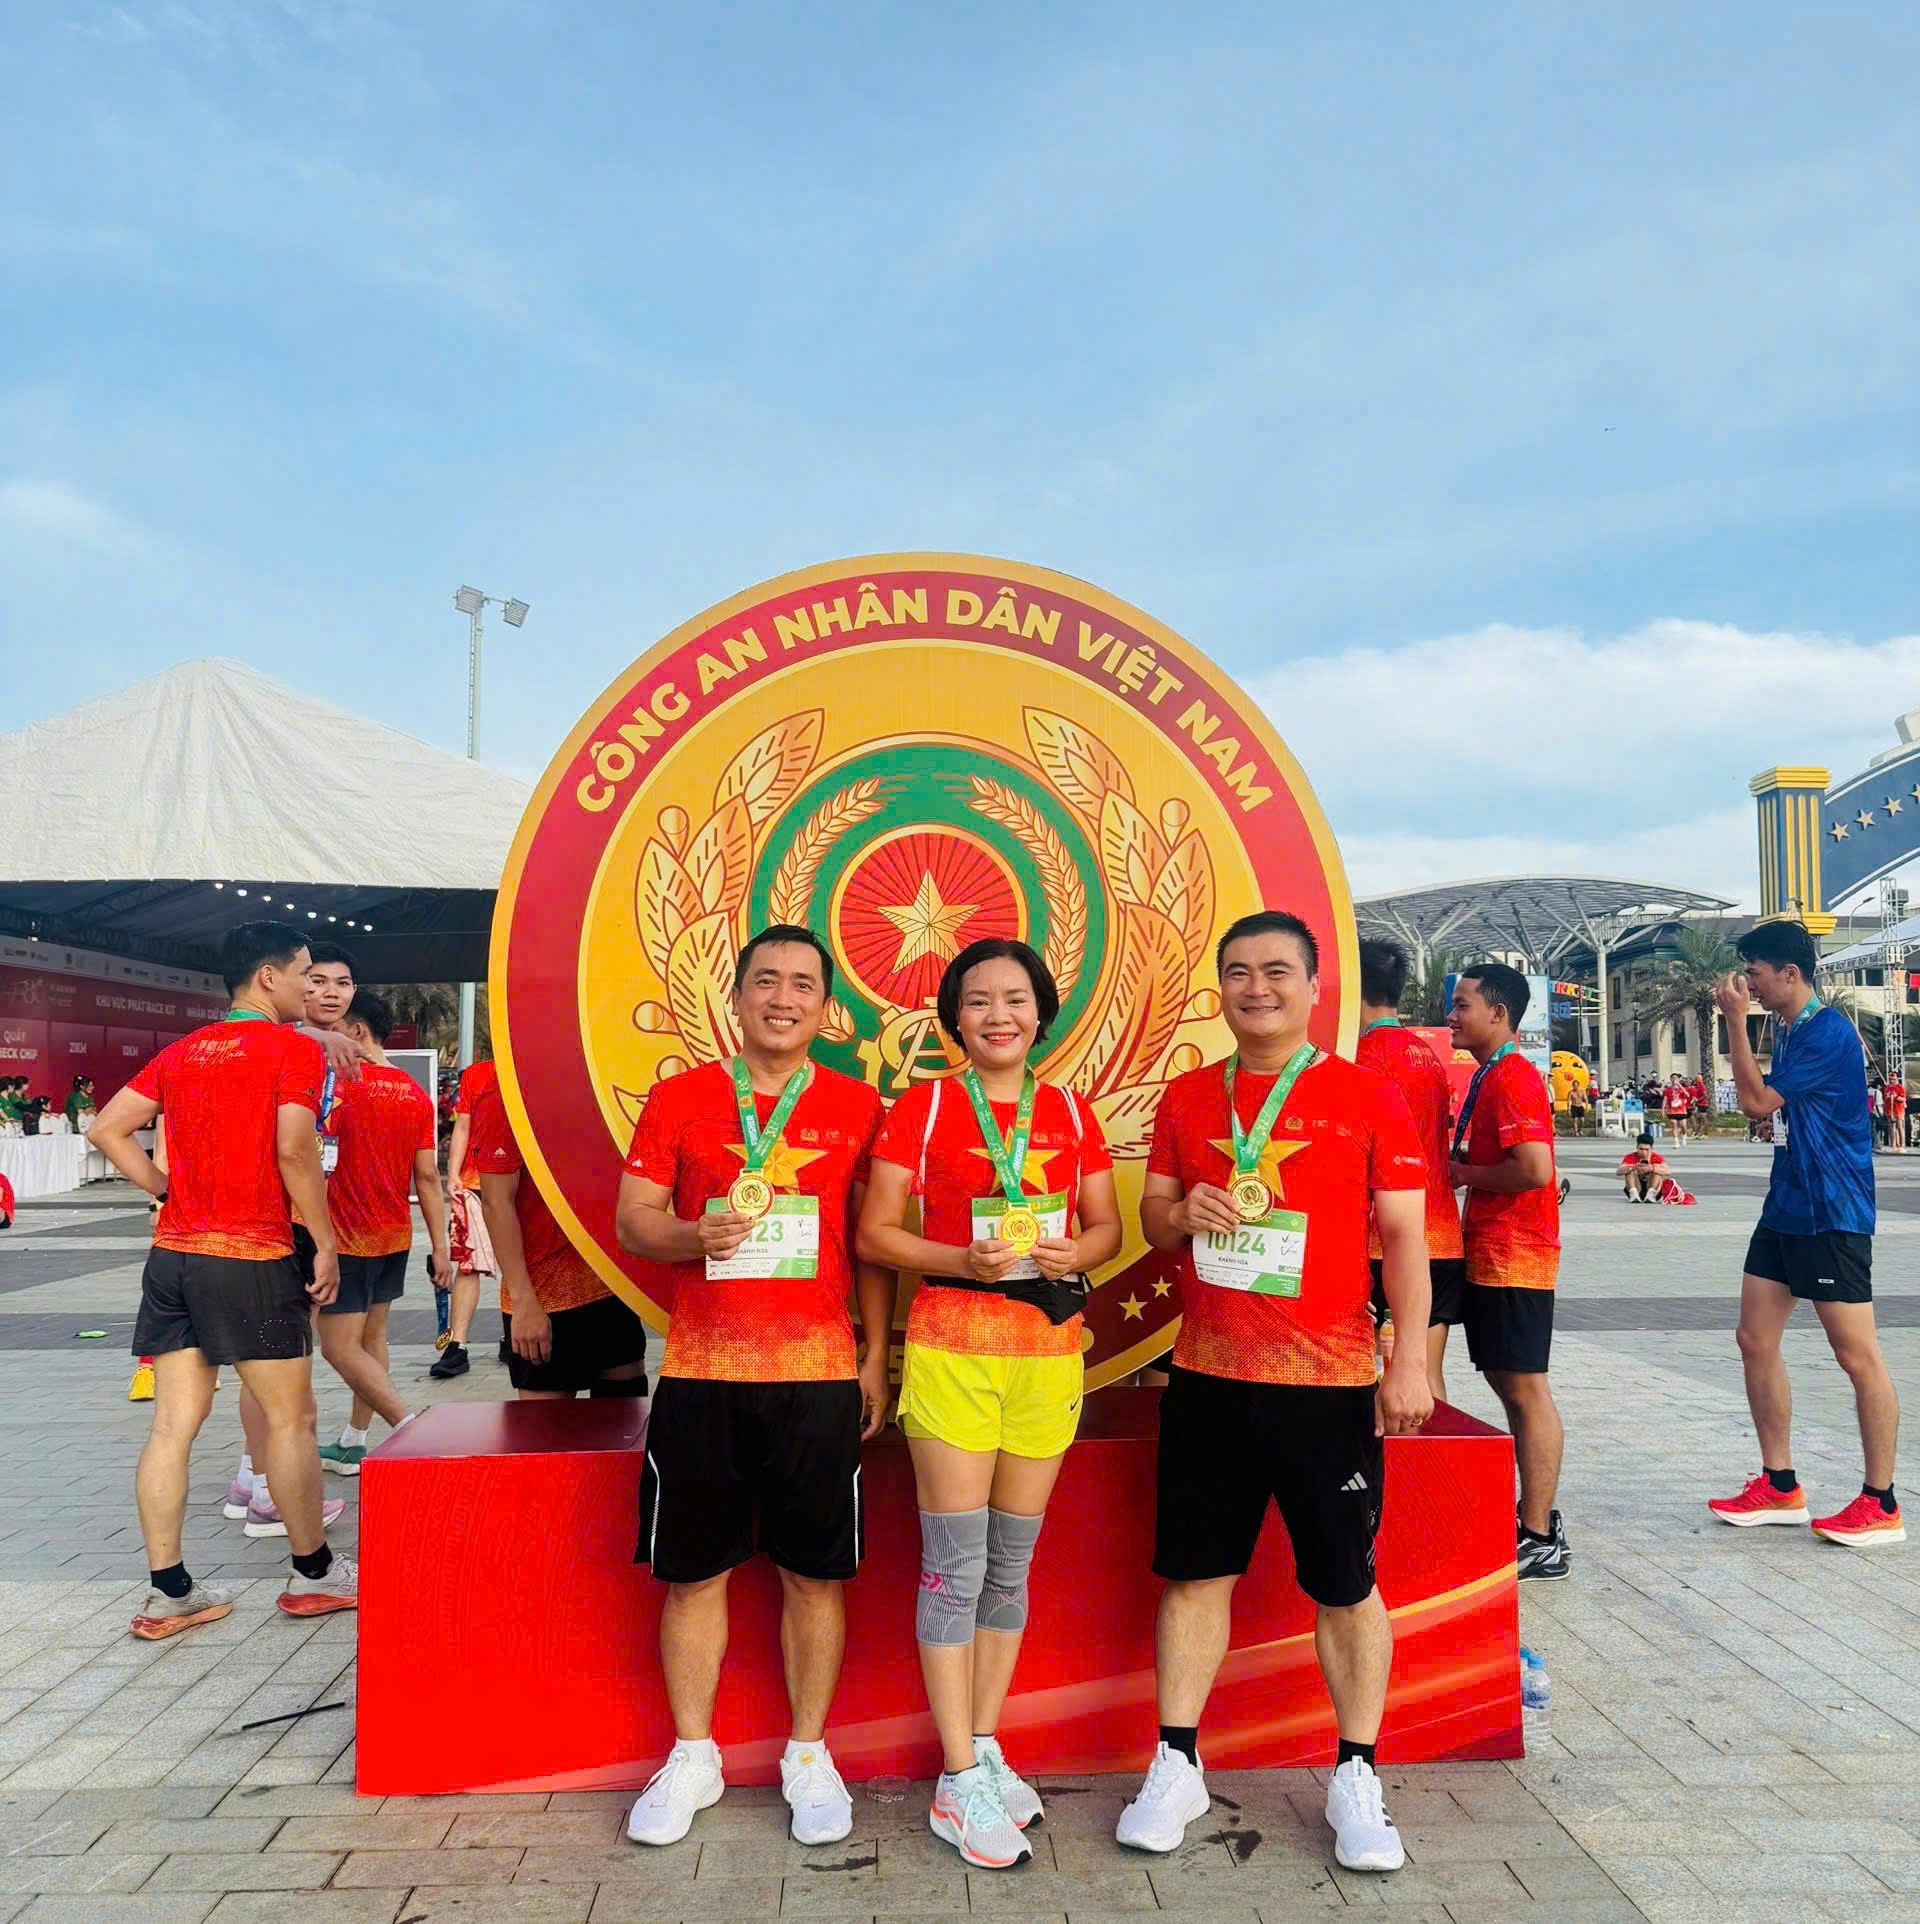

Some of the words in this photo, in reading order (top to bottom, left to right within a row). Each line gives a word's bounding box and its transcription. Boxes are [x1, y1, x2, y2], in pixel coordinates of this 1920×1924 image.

[577, 682, 691, 812] CÔNG
[696, 627, 768, 695] AN
[773, 582, 928, 649] NHÂN
[946, 586, 1062, 646] DÂN
[1078, 620, 1184, 705] VIỆT
[1176, 699, 1273, 812] NAM
[1207, 1229, 1267, 1257] 10124
